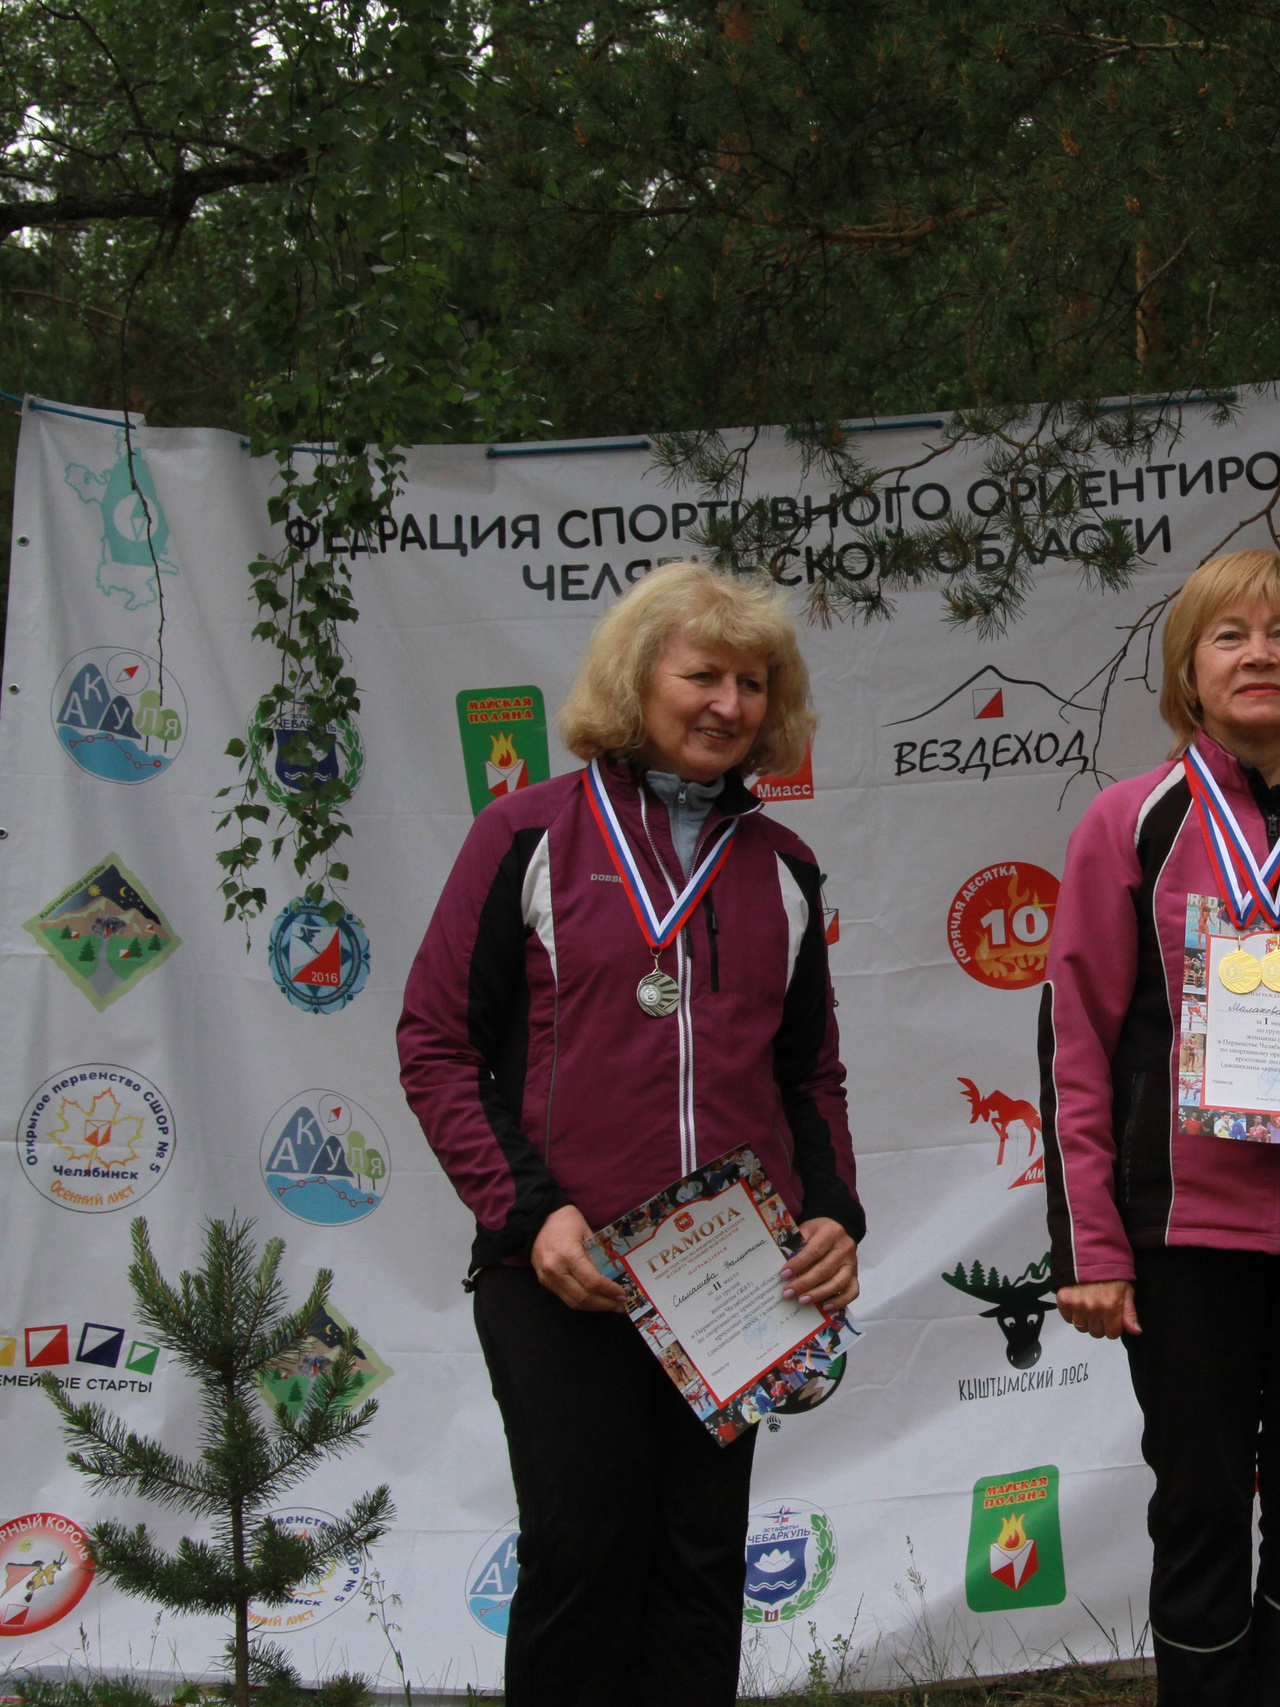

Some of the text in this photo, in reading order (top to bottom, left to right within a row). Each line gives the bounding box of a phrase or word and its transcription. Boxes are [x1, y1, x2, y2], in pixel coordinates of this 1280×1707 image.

[468, 697, 532, 711] МАЙСКАЯ
[469, 710, 533, 723] ПОЛЯНА
[893, 730, 1090, 782] ВЕЗДЕХОД
[756, 783, 812, 798] Миасс
[950, 865, 1018, 965] ГОРЯЧАЯ ДЕСЯТКА
[980, 905, 1049, 945] 10
[311, 971, 338, 984] 2016
[26, 1071, 170, 1173] Открытое первенство СШОР № 5
[53, 1164, 139, 1180] Челябинск
[646, 1206, 741, 1274] ГРАМОТА
[87, 1379, 152, 1393] СТАРТЫ
[958, 1362, 1089, 1401] КЫШТЫМСКИЙ ЛОСЬ
[985, 1476, 1049, 1497] МАЙСКАЯ
[983, 1489, 1047, 1509] ПОЛЯНА
[46, 1516, 88, 1561] КОРОЛЬ
[747, 1528, 811, 1543] ЧЕБАРКУЛЬ
[763, 1524, 799, 1533] эстафеты
